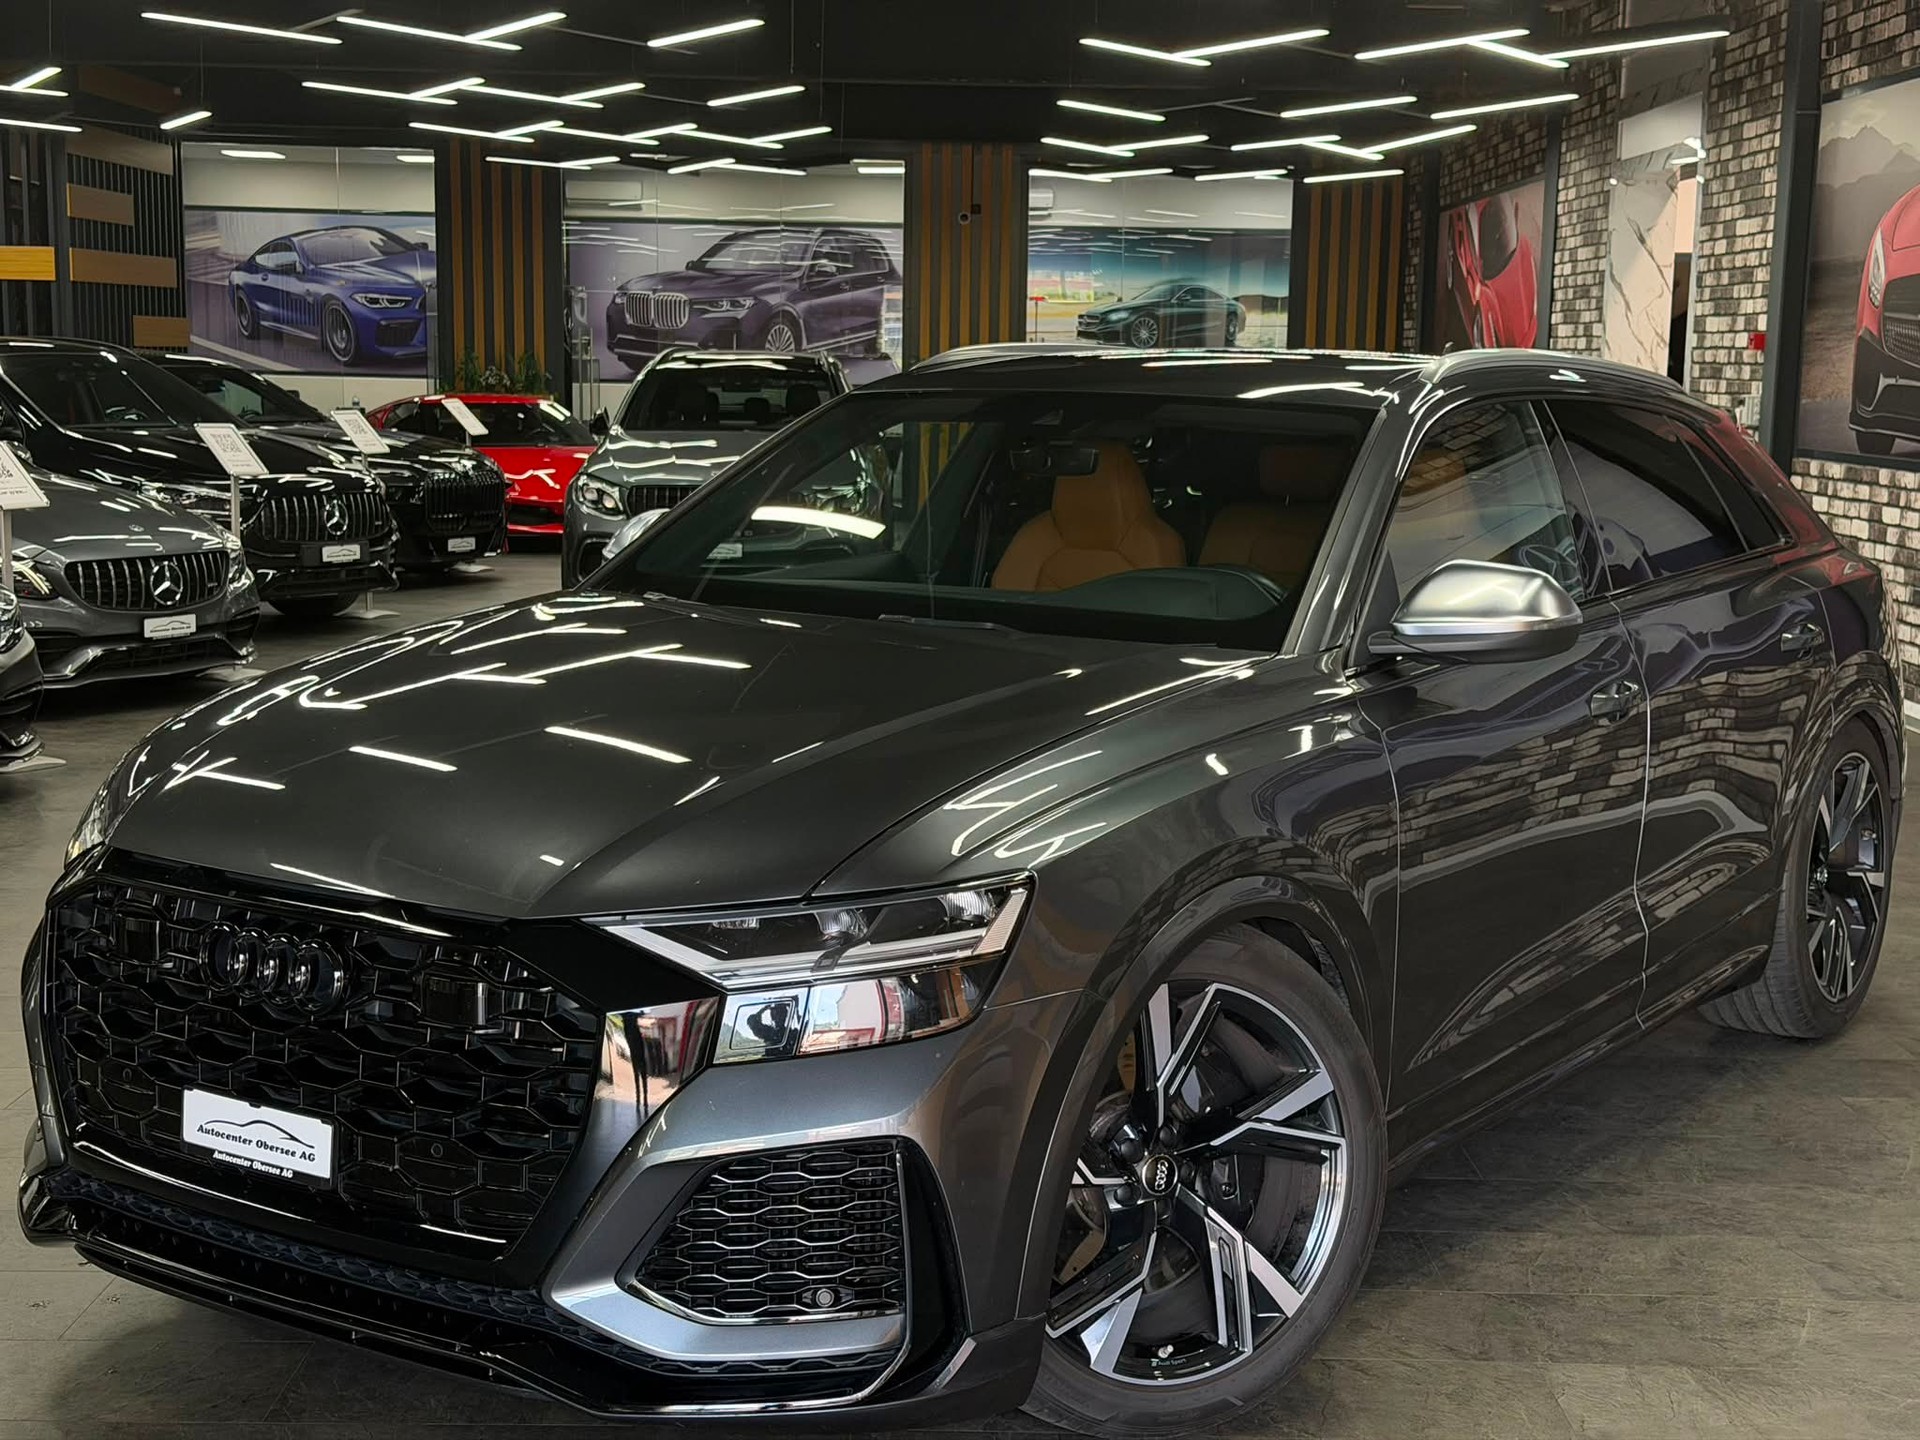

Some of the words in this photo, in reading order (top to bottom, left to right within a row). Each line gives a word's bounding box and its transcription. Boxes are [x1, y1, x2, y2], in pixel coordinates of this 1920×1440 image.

[196, 1124, 253, 1146] Autocenter
[255, 1139, 296, 1158] Obersee
[299, 1150, 316, 1163] AG
[213, 1150, 252, 1168] Autocenter
[252, 1160, 281, 1175] Obersee
[281, 1168, 294, 1179] AG
